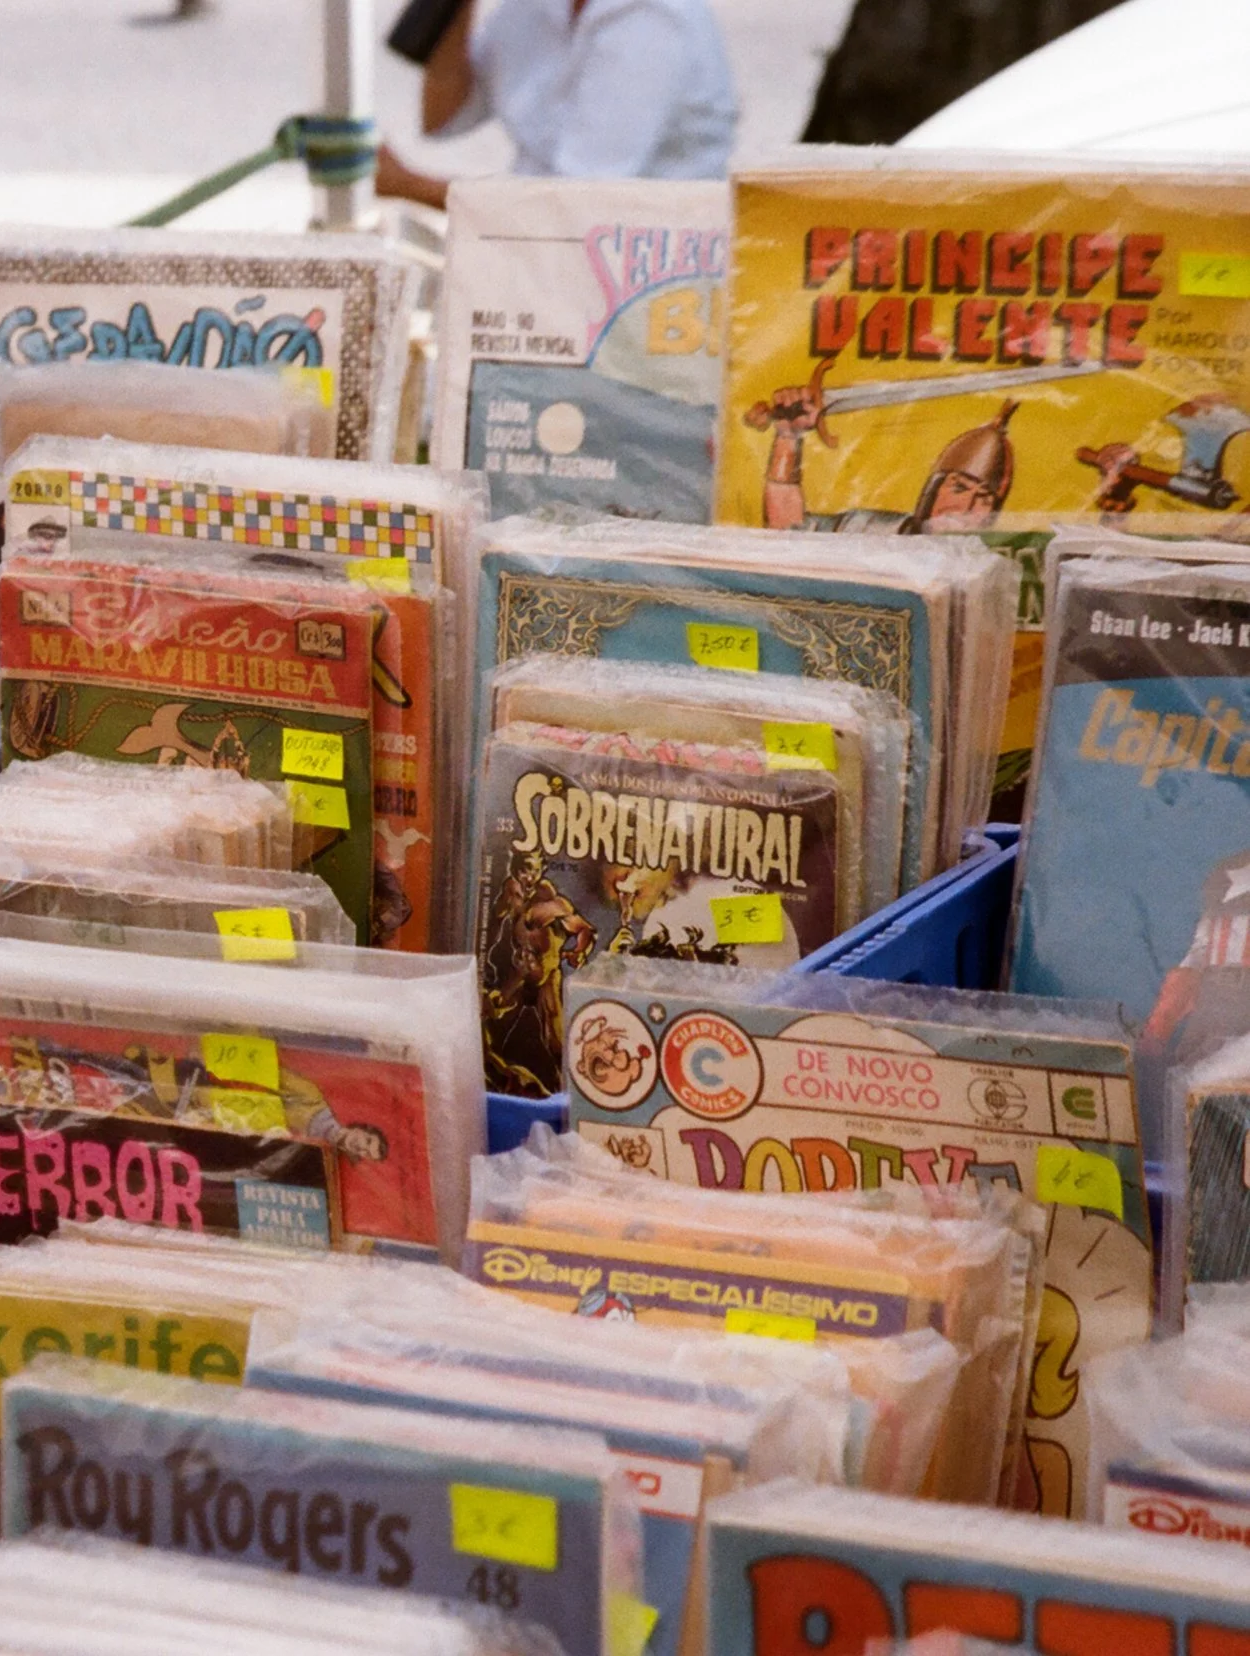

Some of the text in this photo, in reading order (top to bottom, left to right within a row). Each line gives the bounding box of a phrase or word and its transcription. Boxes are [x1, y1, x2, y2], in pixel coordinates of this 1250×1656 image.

[803, 226, 1165, 300] PRINCIPE
[809, 293, 1150, 368] VALENTE
[1090, 609, 1136, 638] Stan
[1140, 615, 1172, 640] Lee
[1188, 619, 1234, 647] Jack
[31, 632, 341, 700] MARAVILHOSA
[496, 817, 515, 834] 33
[512, 772, 808, 889] SOBRENATURAL
[782, 1074, 941, 1111] CONVOSCO
[797, 1048, 934, 1084] DE NOVO
[243, 1183, 320, 1210] REVISTA
[257, 1205, 307, 1228] PARA
[482, 1246, 879, 1328] Disney ESPECIALÍSSIMO
[16, 1424, 414, 1589] Roy Rogers
